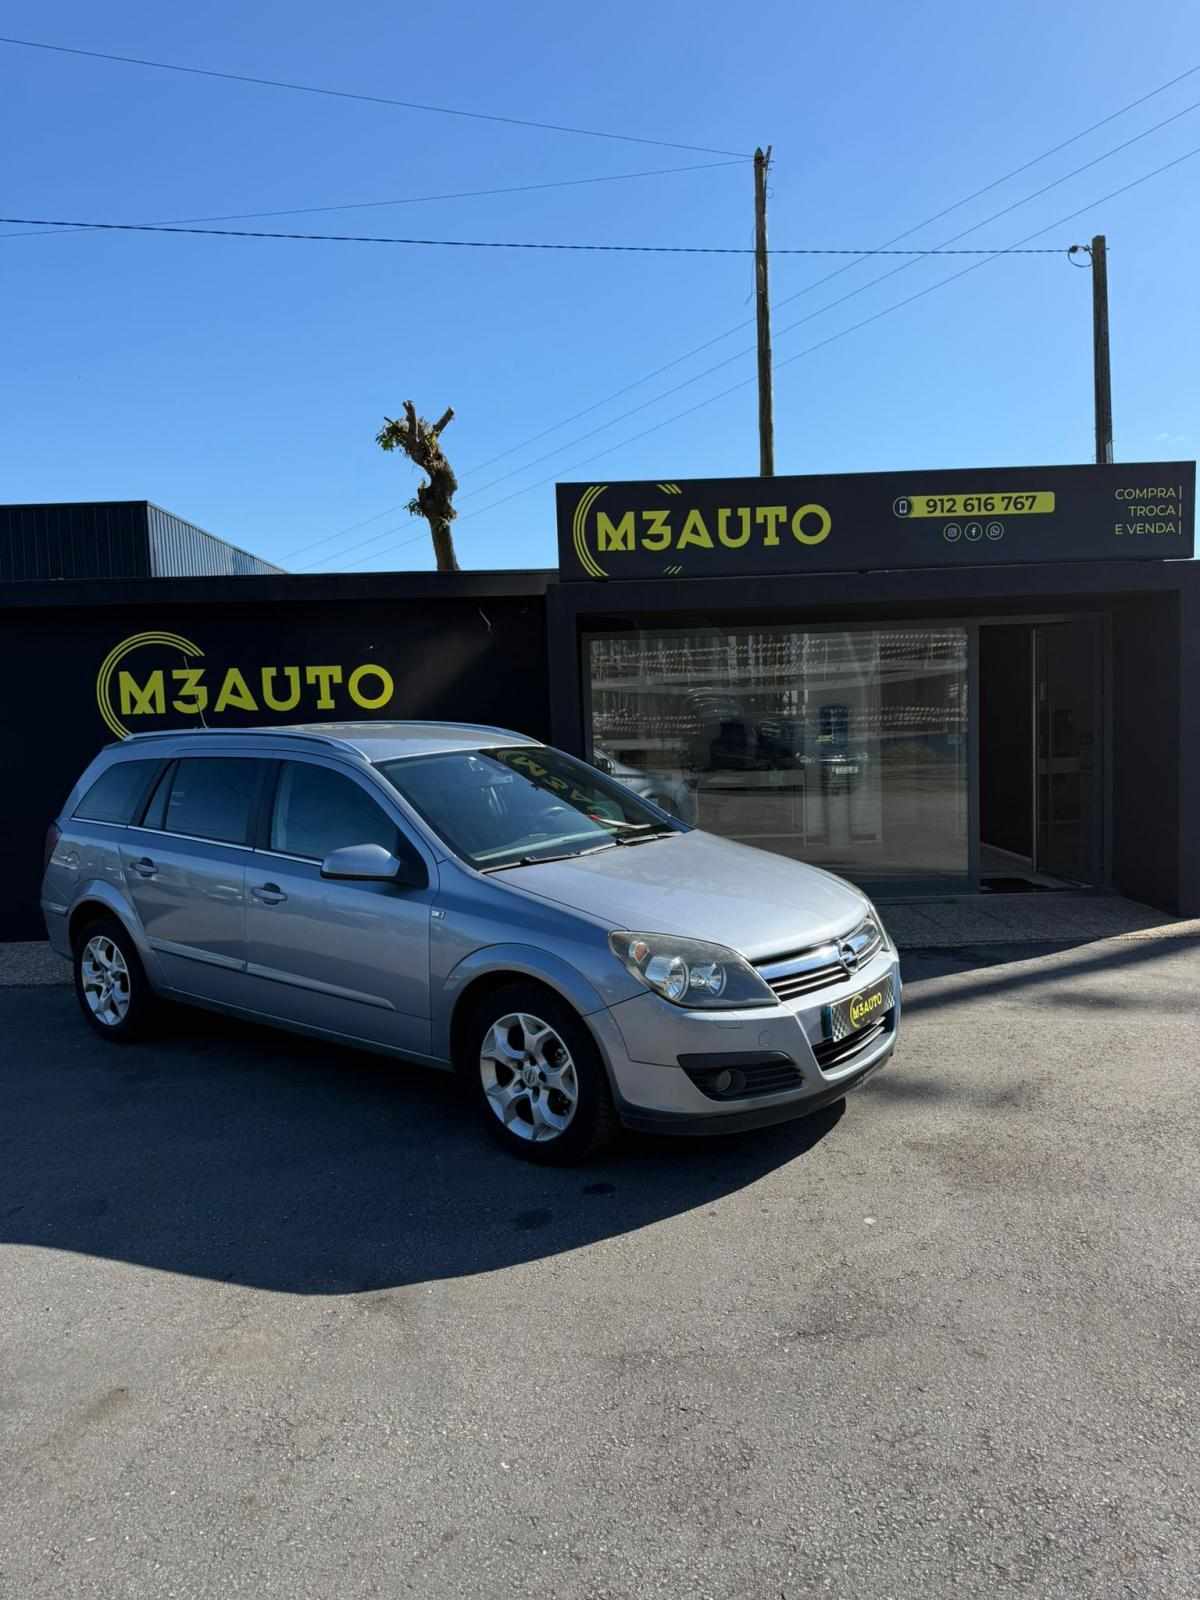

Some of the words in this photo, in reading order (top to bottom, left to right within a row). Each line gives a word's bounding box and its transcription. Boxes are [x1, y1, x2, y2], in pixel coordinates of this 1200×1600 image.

[1114, 487, 1177, 500] COMPRA
[926, 498, 957, 514] 912
[963, 496, 995, 512] 616
[1001, 495, 1037, 511] 767
[1128, 504, 1176, 517] TROCA
[1114, 523, 1124, 535] E
[1126, 522, 1176, 535] VENDA
